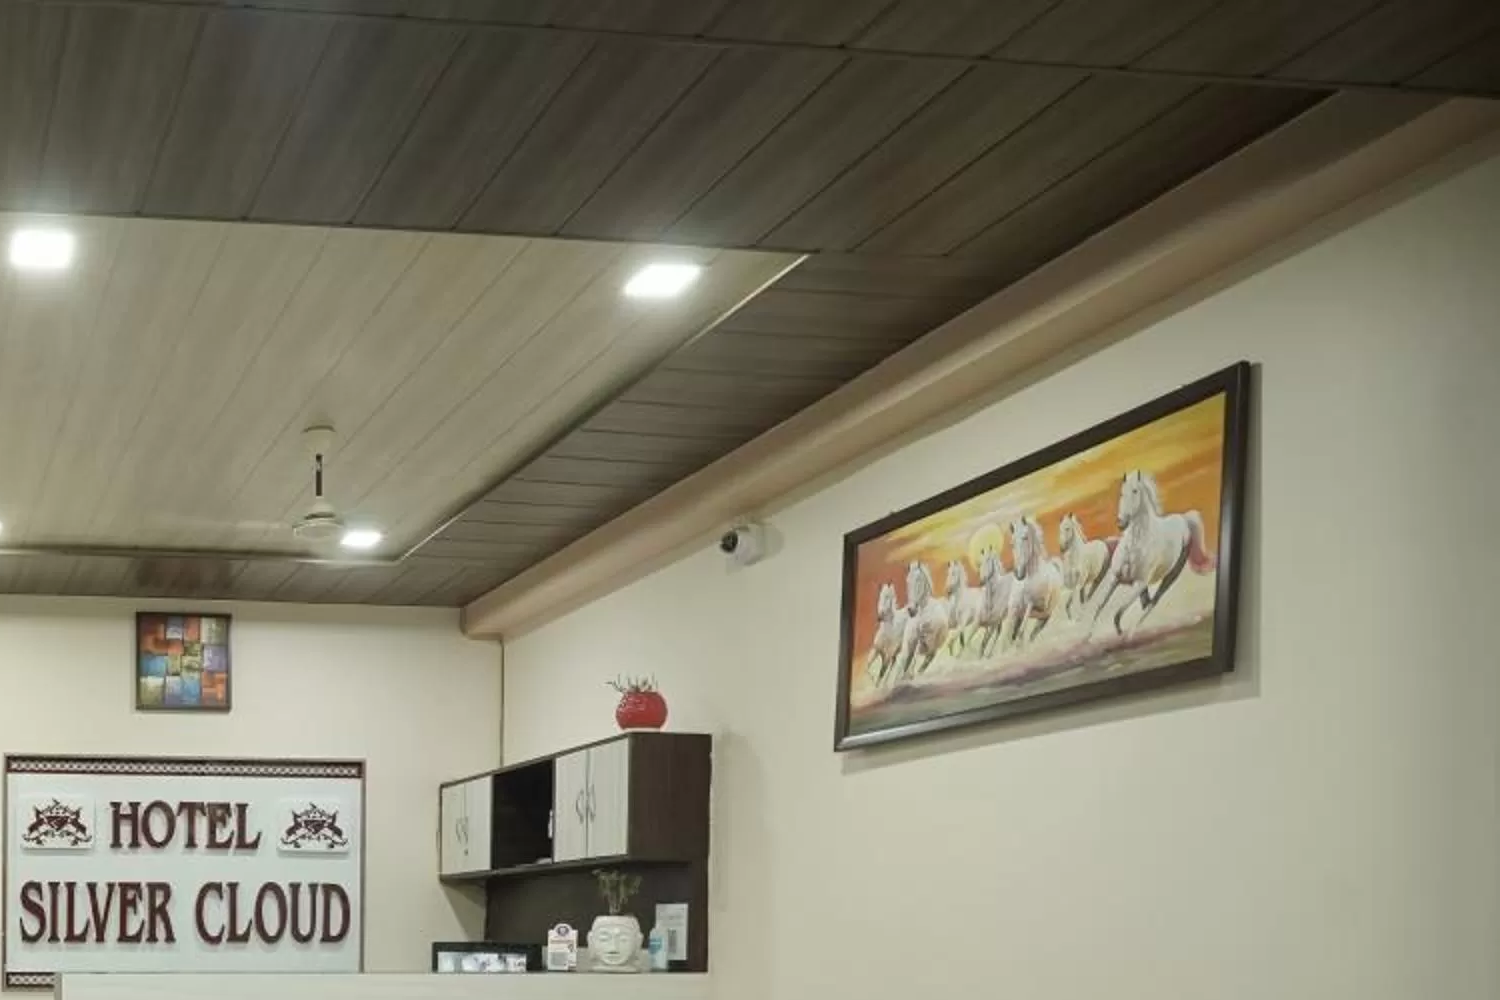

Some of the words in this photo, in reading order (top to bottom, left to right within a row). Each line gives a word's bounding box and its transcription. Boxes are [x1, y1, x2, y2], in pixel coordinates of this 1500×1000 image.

[110, 801, 261, 850] HOTEL
[20, 881, 176, 944] SILVER
[195, 881, 351, 945] CLOUD
